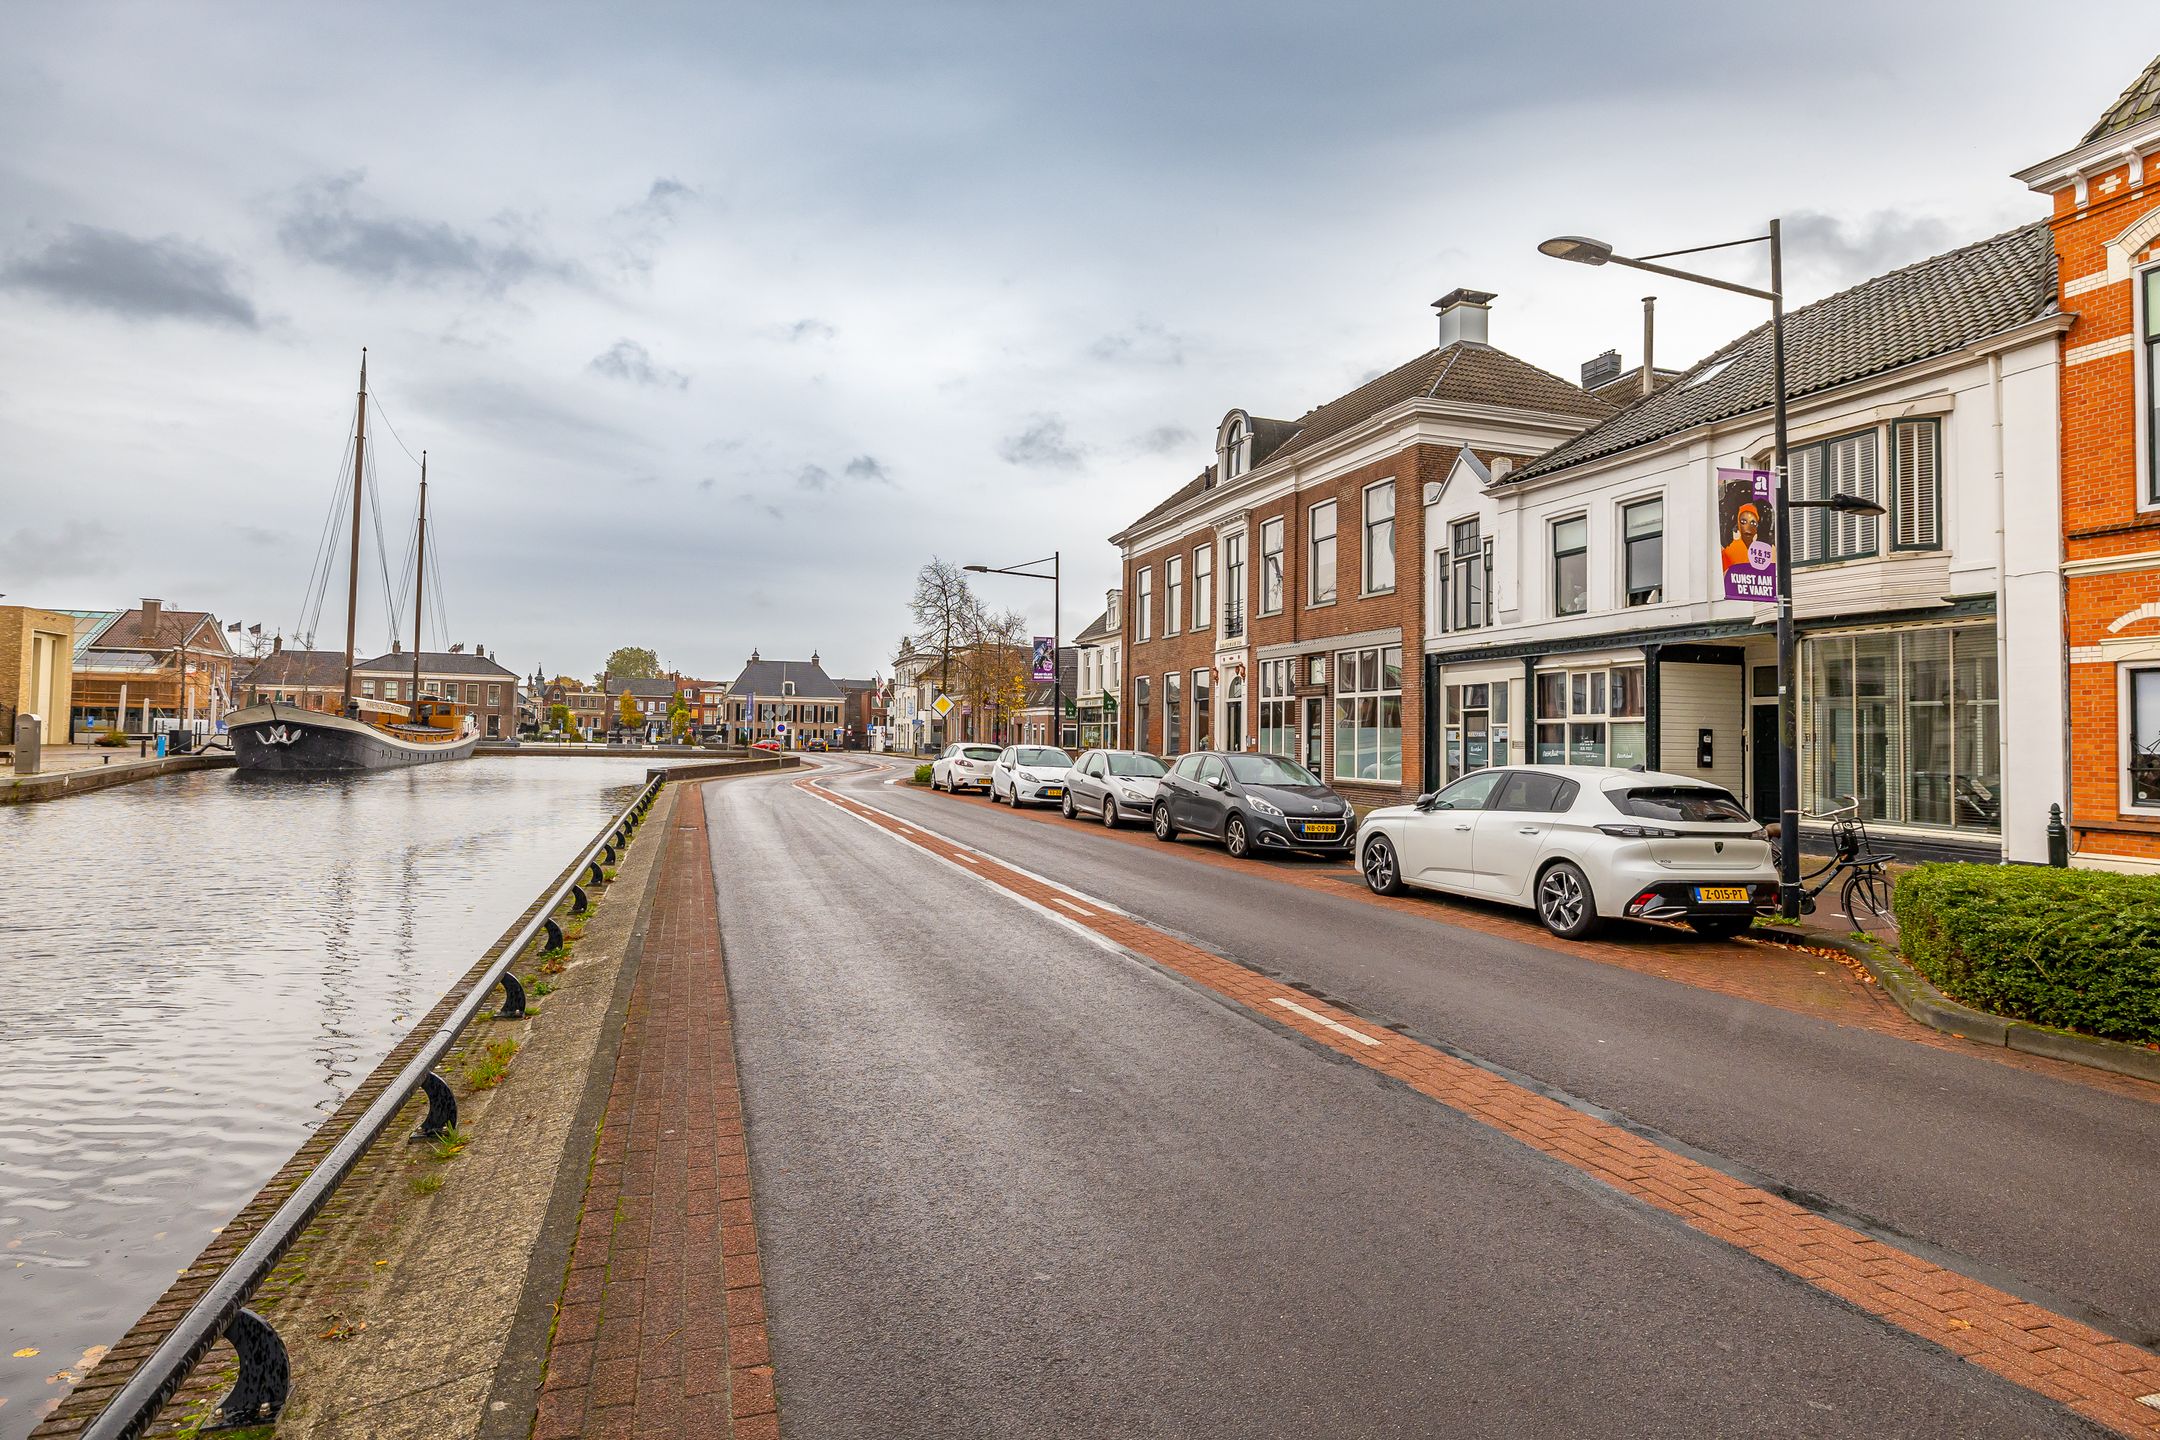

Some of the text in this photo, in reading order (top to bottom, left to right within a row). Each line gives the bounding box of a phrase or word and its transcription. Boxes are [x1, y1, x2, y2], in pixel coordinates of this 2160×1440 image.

[1754, 476, 1767, 491] a
[1750, 548, 1771, 559] 14 & 15
[1754, 556, 1766, 565] SEP
[1731, 573, 1773, 586] KUNST AAN
[1737, 584, 1774, 597] DE VAART
[1704, 889, 1743, 900] Z-015-PT
